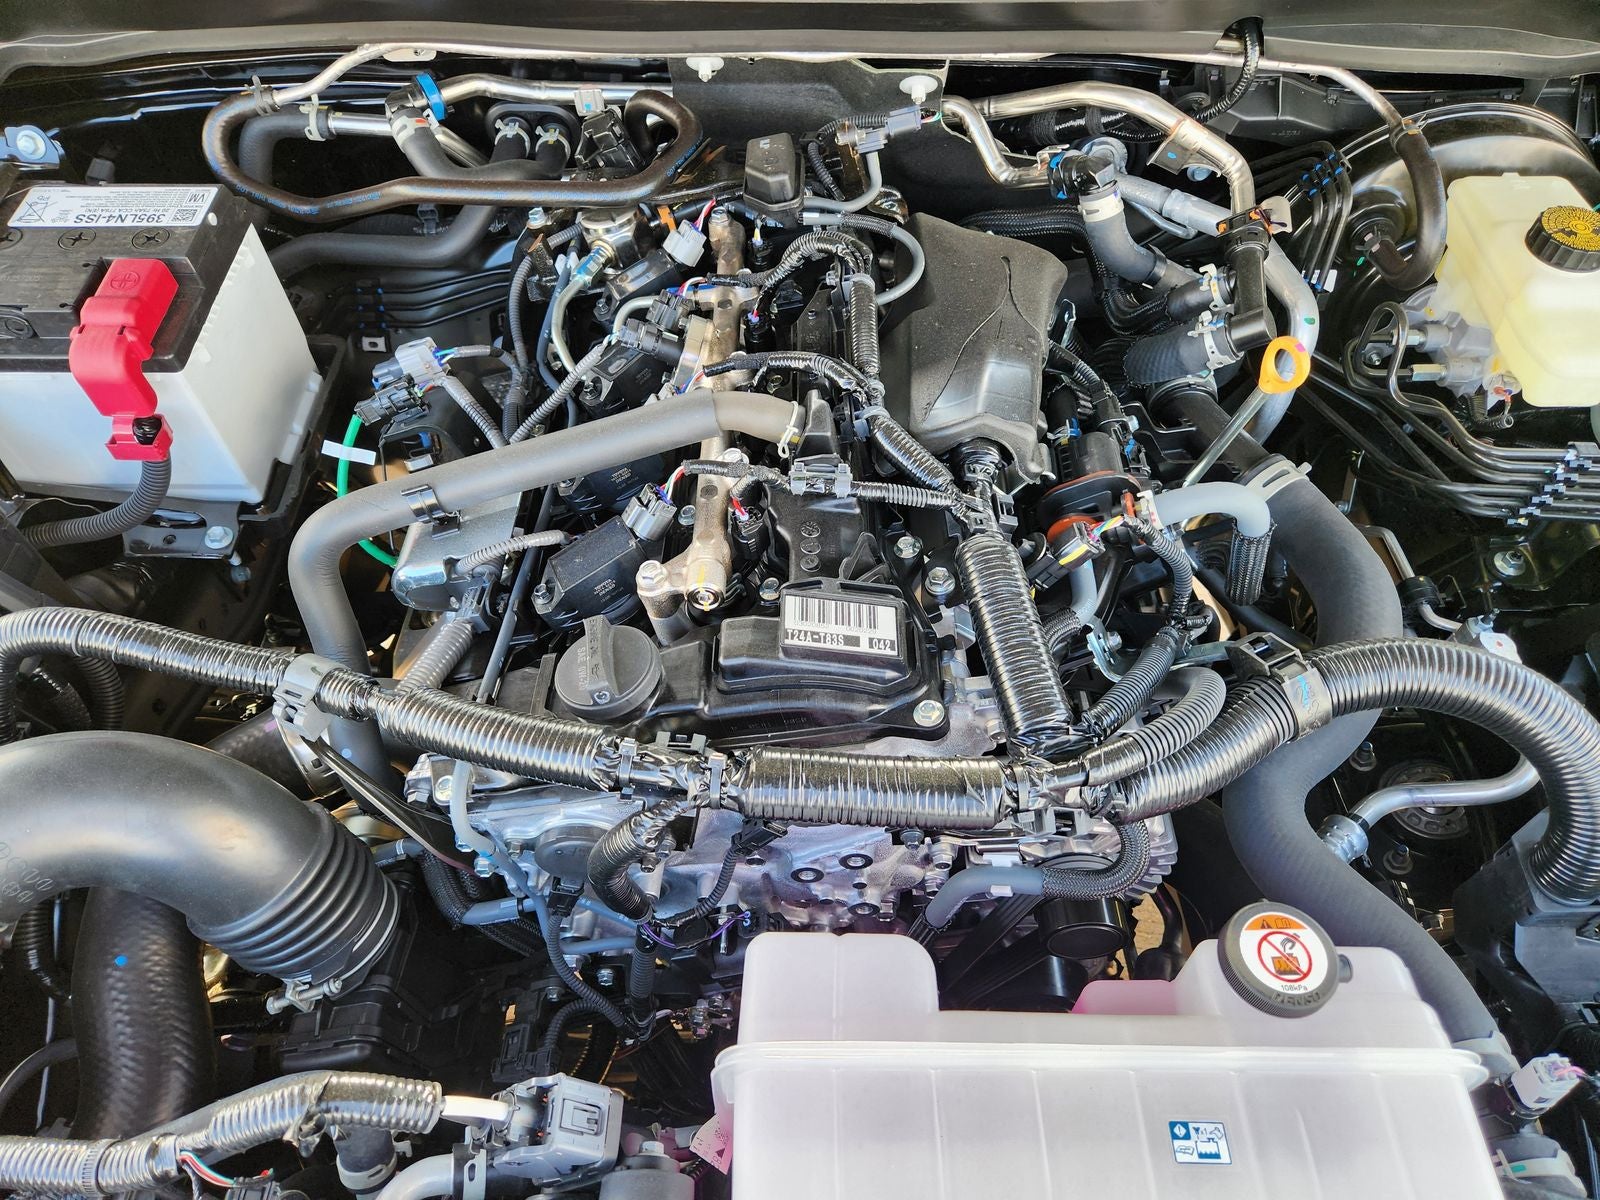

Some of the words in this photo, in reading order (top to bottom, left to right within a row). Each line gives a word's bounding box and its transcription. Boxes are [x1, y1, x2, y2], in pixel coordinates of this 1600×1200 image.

[188, 192, 206, 203] VM
[73, 213, 166, 224] 395LN4-ISS
[786, 629, 845, 646] T24A-T83S
[872, 638, 891, 650] 042
[1281, 984, 1309, 992] 108kPa
[1271, 991, 1321, 1007] DENSO
